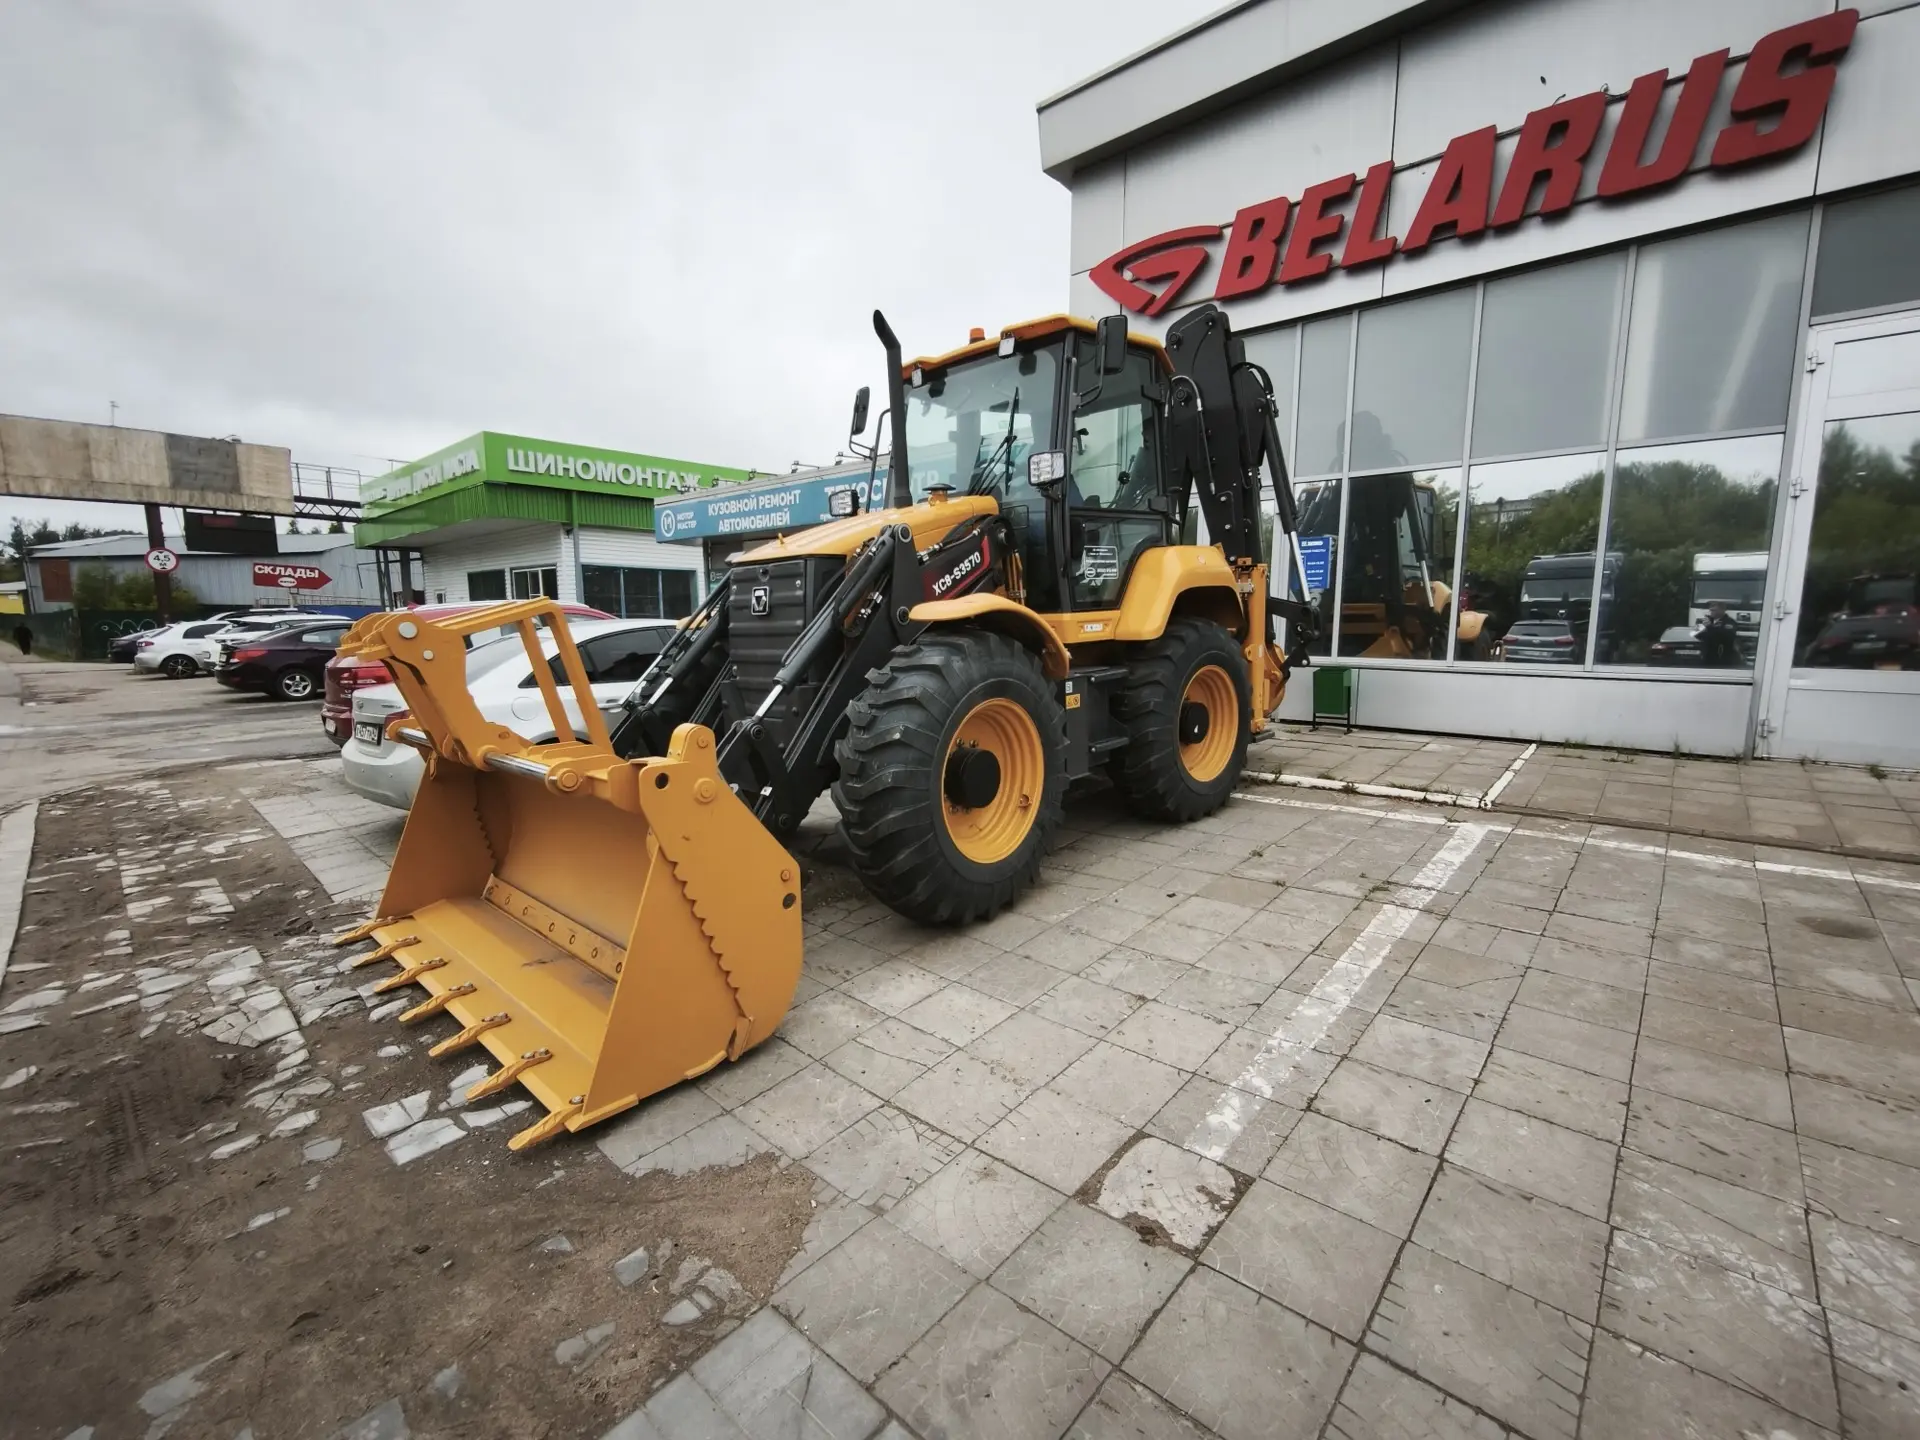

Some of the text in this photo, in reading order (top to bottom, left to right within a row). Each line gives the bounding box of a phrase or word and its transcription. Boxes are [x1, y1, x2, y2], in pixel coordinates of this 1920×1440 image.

[1215, 9, 1859, 300] BELARUS
[507, 448, 700, 491] ШИНОМОНТАЖ
[708, 489, 801, 516] КУЗОВНОЙ РЕМОНТ
[718, 508, 790, 532] АВТОМОБИЛЕЙ
[254, 565, 319, 579] СКЛАДЫ
[932, 551, 981, 596] XC8-S3570
